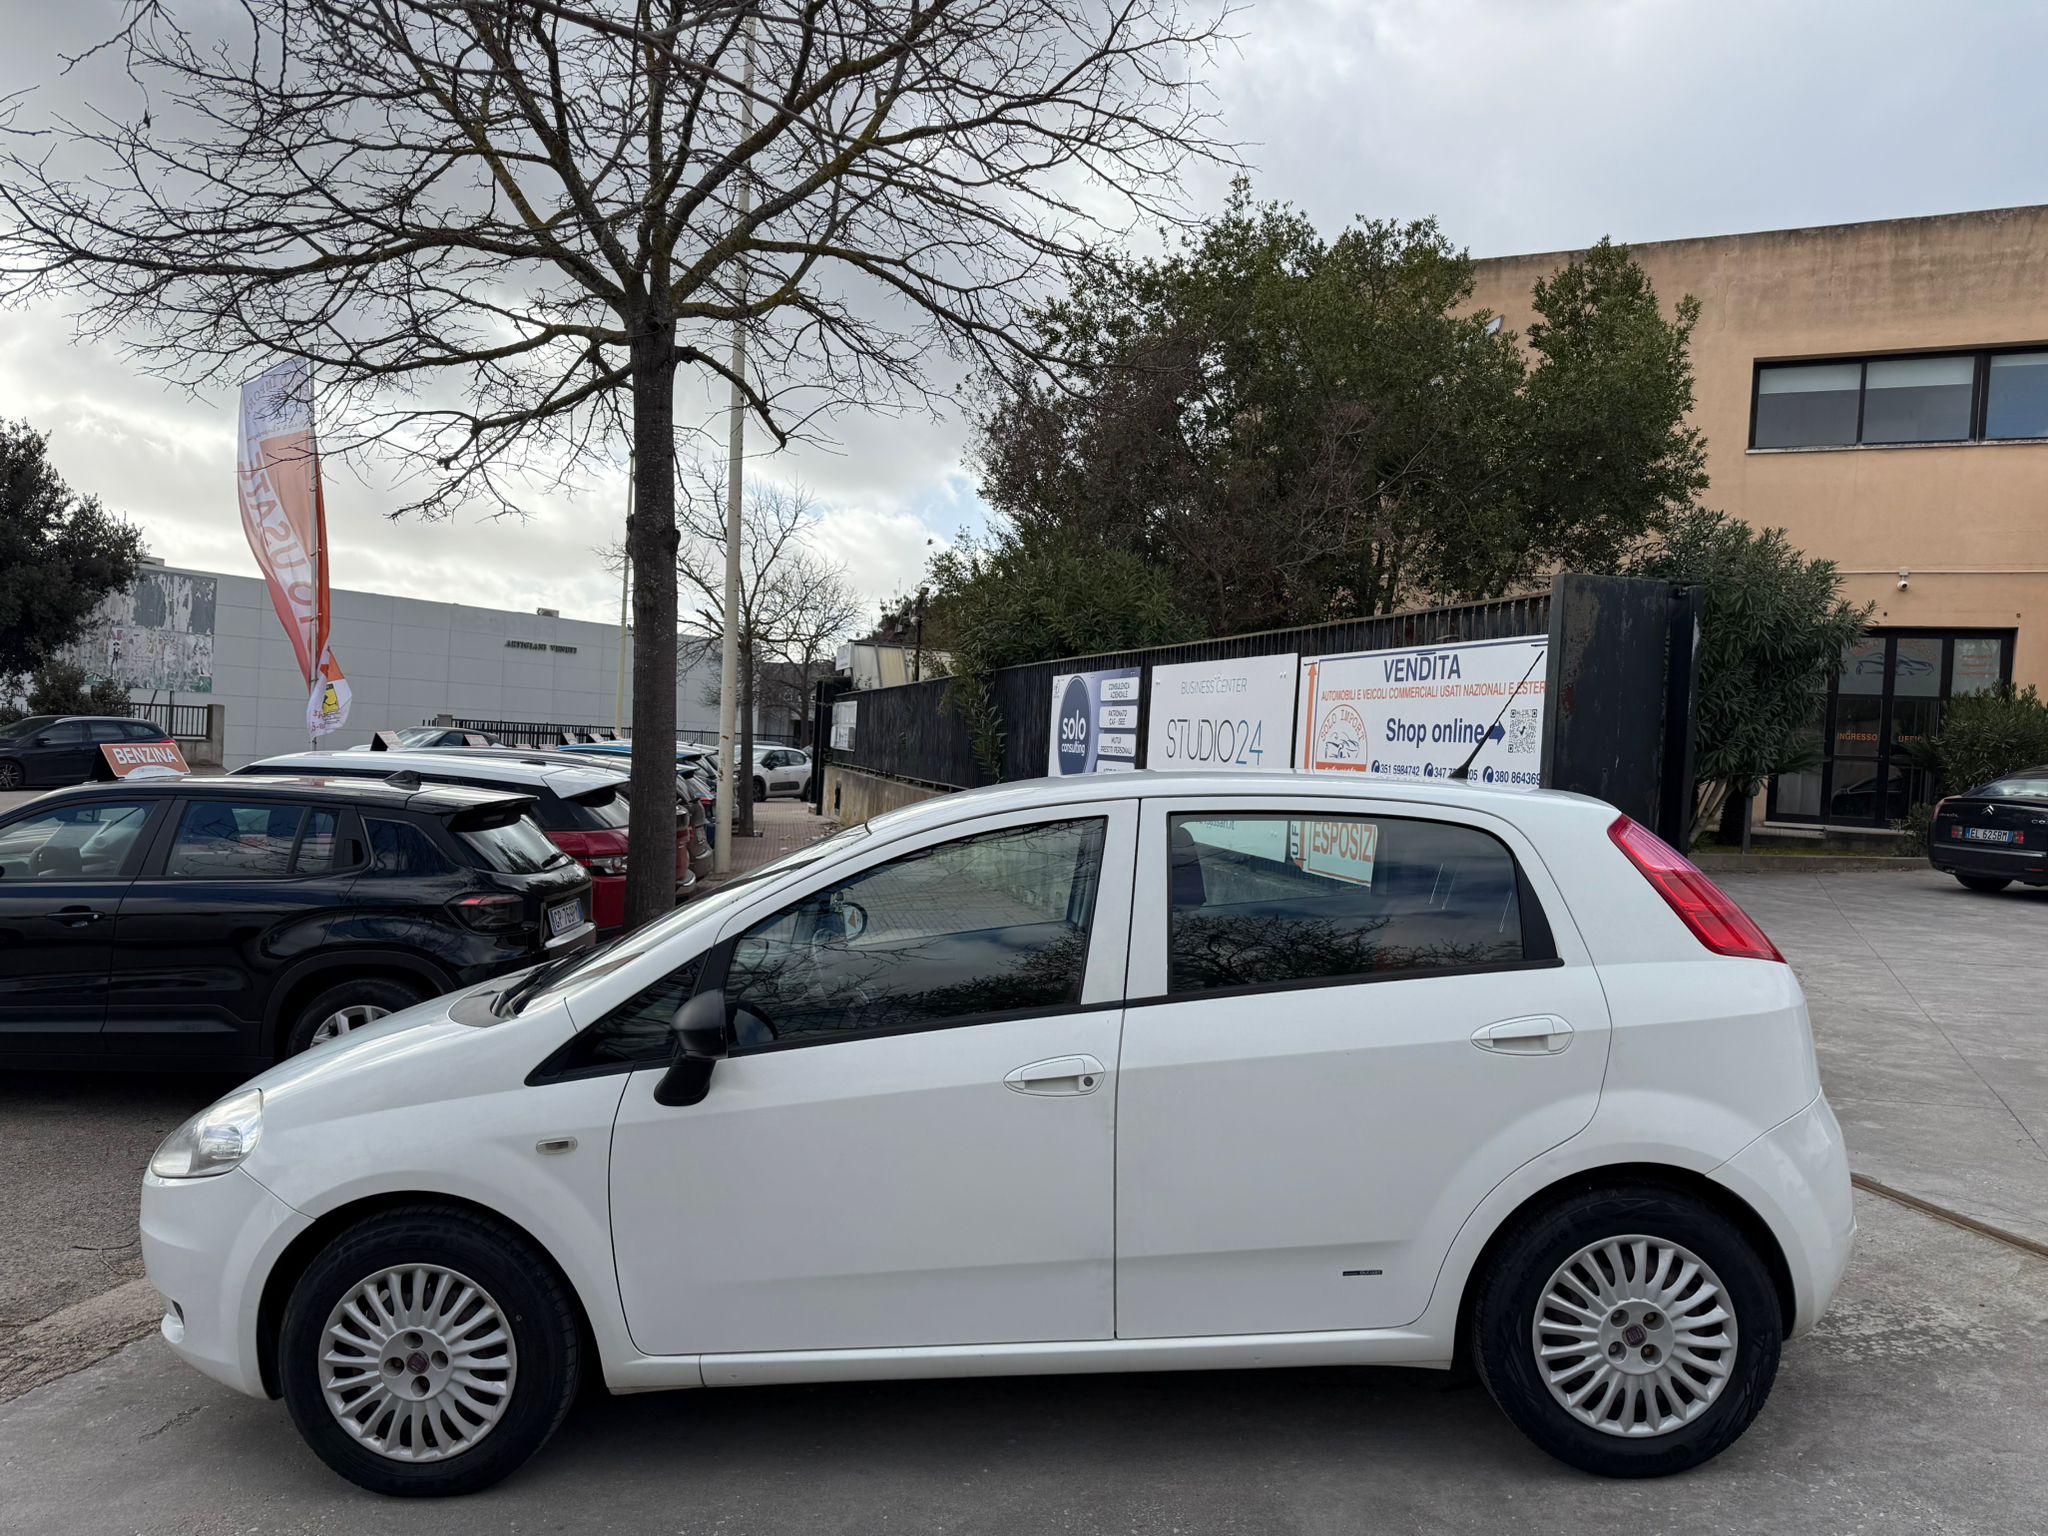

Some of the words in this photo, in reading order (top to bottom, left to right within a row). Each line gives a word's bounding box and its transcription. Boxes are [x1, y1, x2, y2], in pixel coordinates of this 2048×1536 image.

[1383, 654, 1461, 682] VENDITA
[1180, 680, 1215, 694] BUSINESS
[1216, 678, 1248, 693] CENTER
[1321, 688, 1356, 701] AUTOMOBILI
[1357, 688, 1362, 700] E
[1363, 687, 1387, 700] VEICOLI
[1389, 685, 1438, 699] COMMERCIALI
[1440, 684, 1461, 697] USATI
[1463, 682, 1506, 696] NAZIONALI
[1508, 682, 1514, 695] E
[1062, 710, 1086, 740] solo
[1320, 712, 1338, 742] SOLO
[1340, 709, 1365, 741] IMPORT
[1385, 718, 1427, 749] Shop
[1431, 718, 1485, 744] online
[1061, 742, 1086, 757] consulting
[1166, 719, 1263, 766] STUDIO24
[112, 747, 179, 764] BENZINA
[1380, 764, 1391, 774] 351
[1393, 765, 1420, 776] 5984742
[1434, 767, 1446, 778] 347
[1494, 773, 1509, 783] 380
[1970, 828, 1980, 839] EL
[1982, 829, 2008, 841] 625BM
